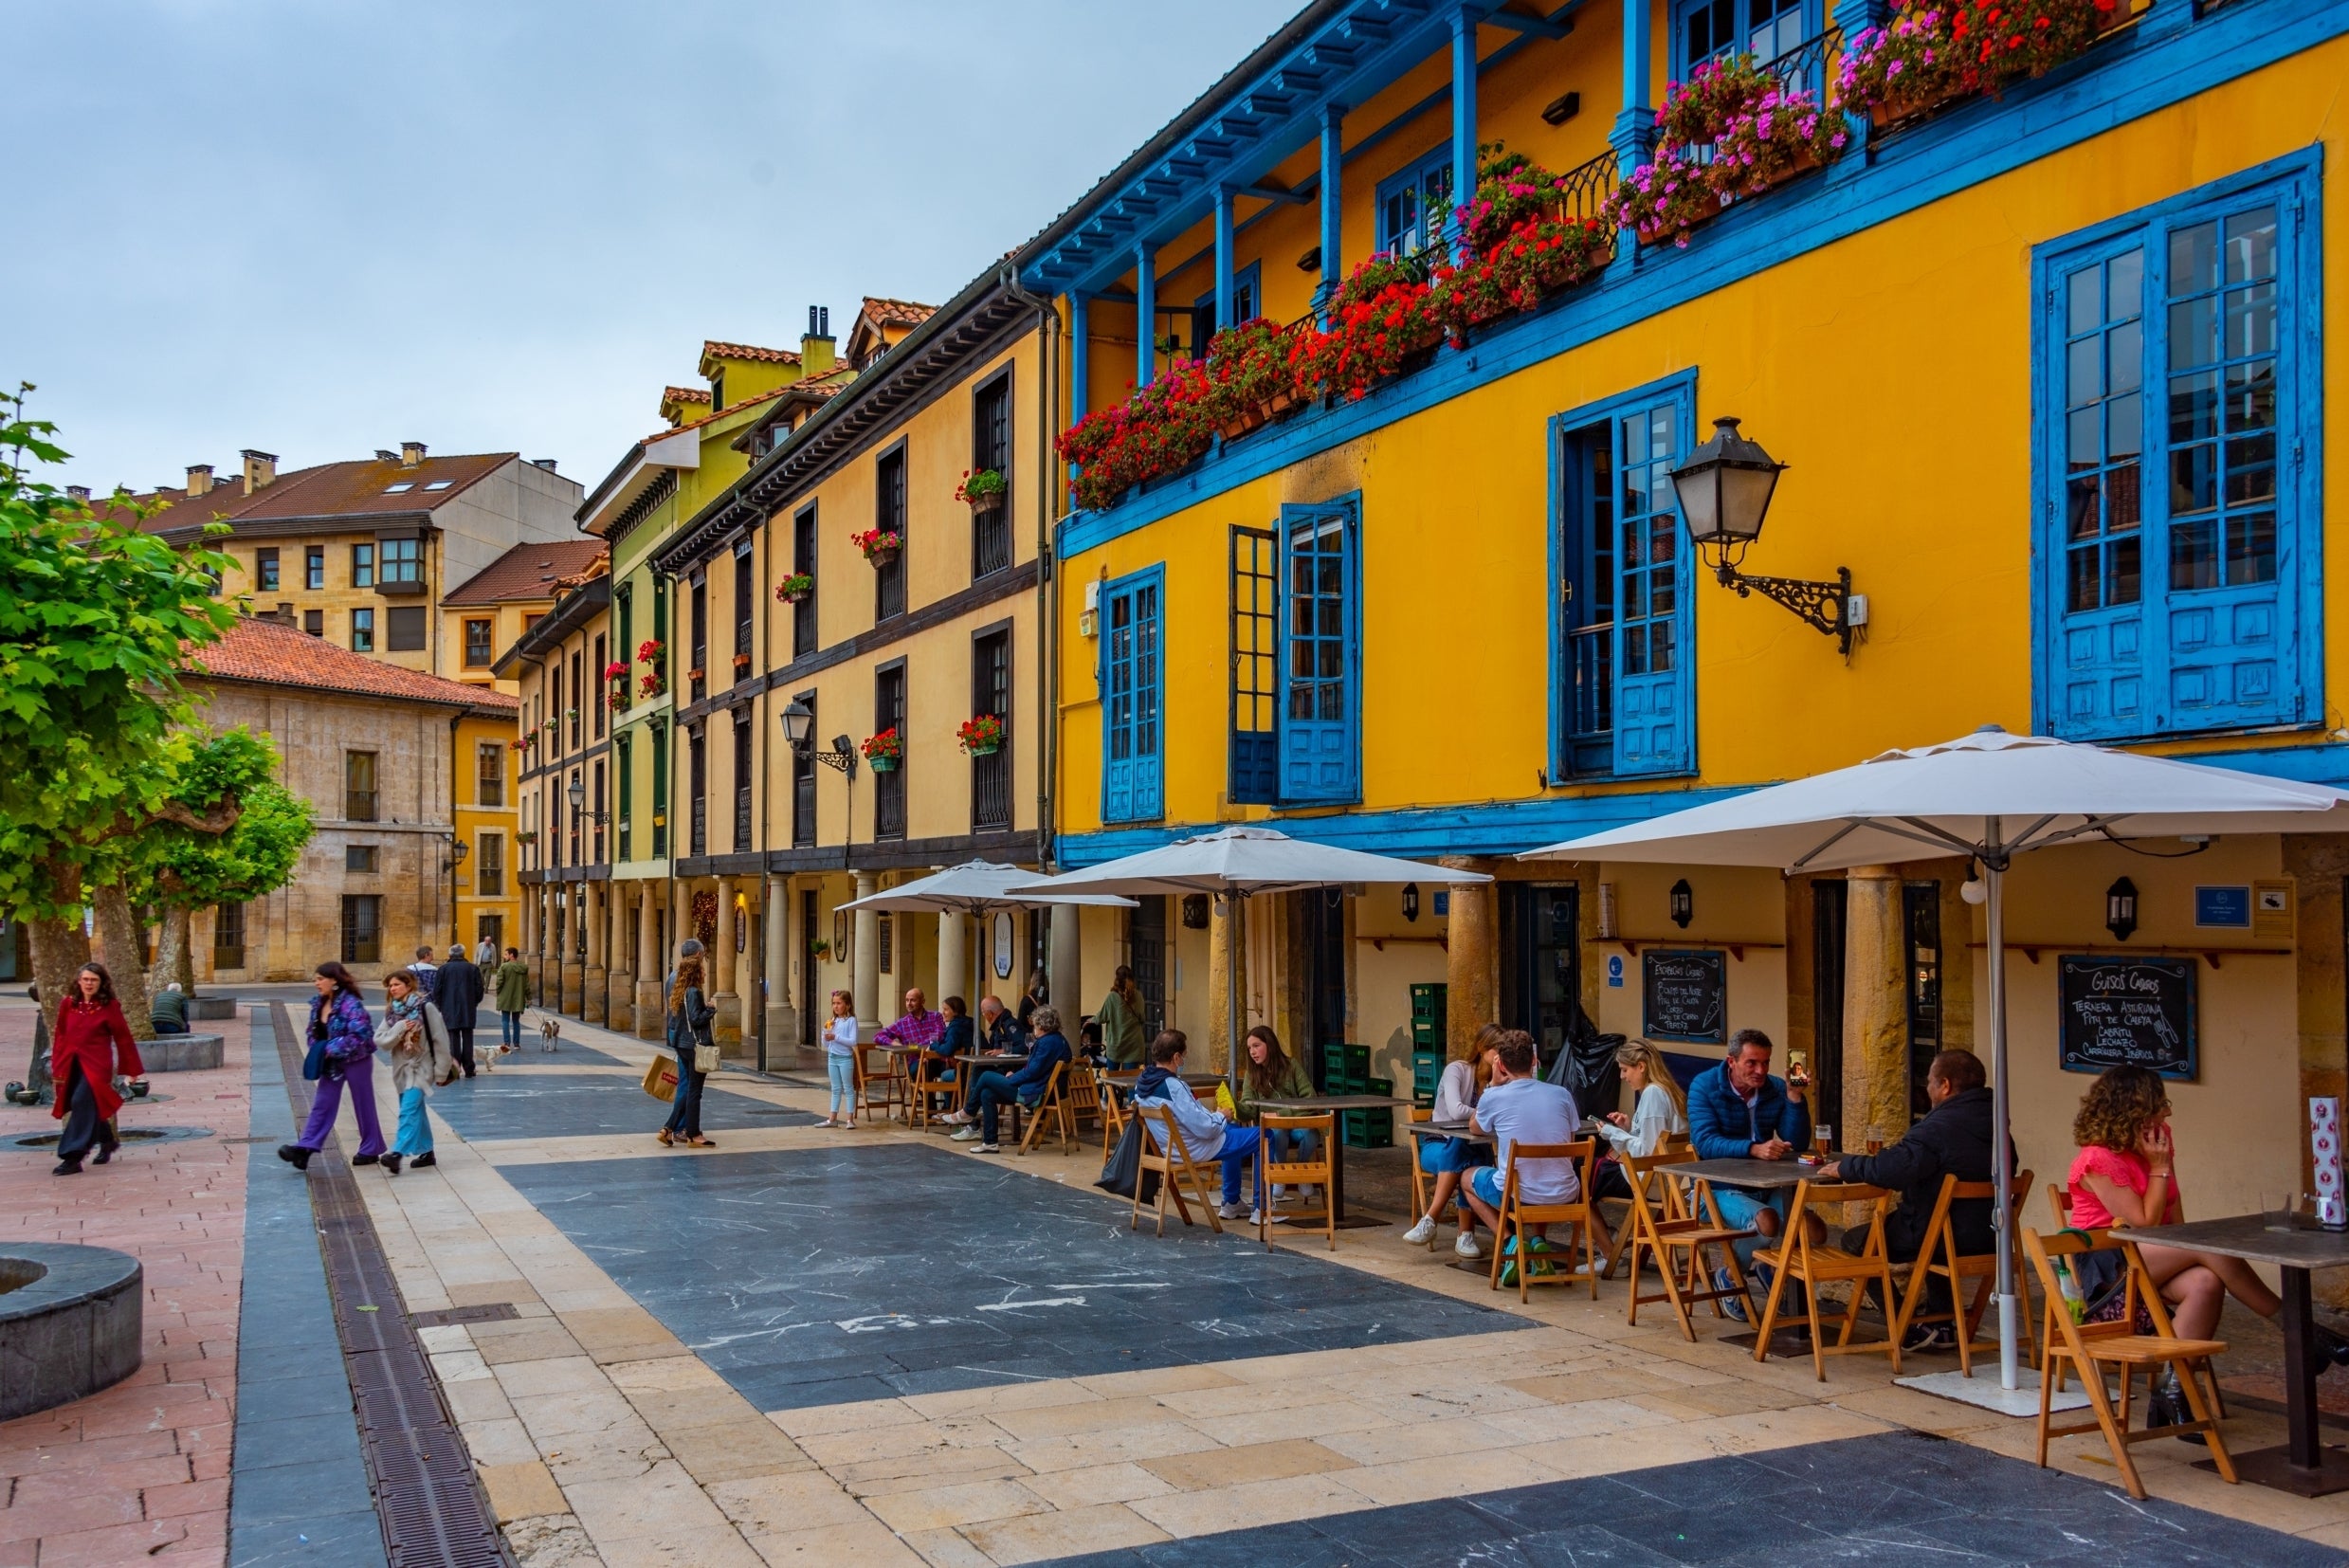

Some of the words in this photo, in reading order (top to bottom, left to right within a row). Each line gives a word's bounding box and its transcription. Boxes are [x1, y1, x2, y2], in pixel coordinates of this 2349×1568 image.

[2092, 972, 2125, 991] GUISOS
[2130, 972, 2159, 994] CASEROS
[2072, 1000, 2112, 1012] TERNERA
[2121, 1001, 2162, 1014] ASTURIANA
[2124, 1013, 2153, 1026] CALEYA
[2096, 1034, 2138, 1048] LECHAZO
